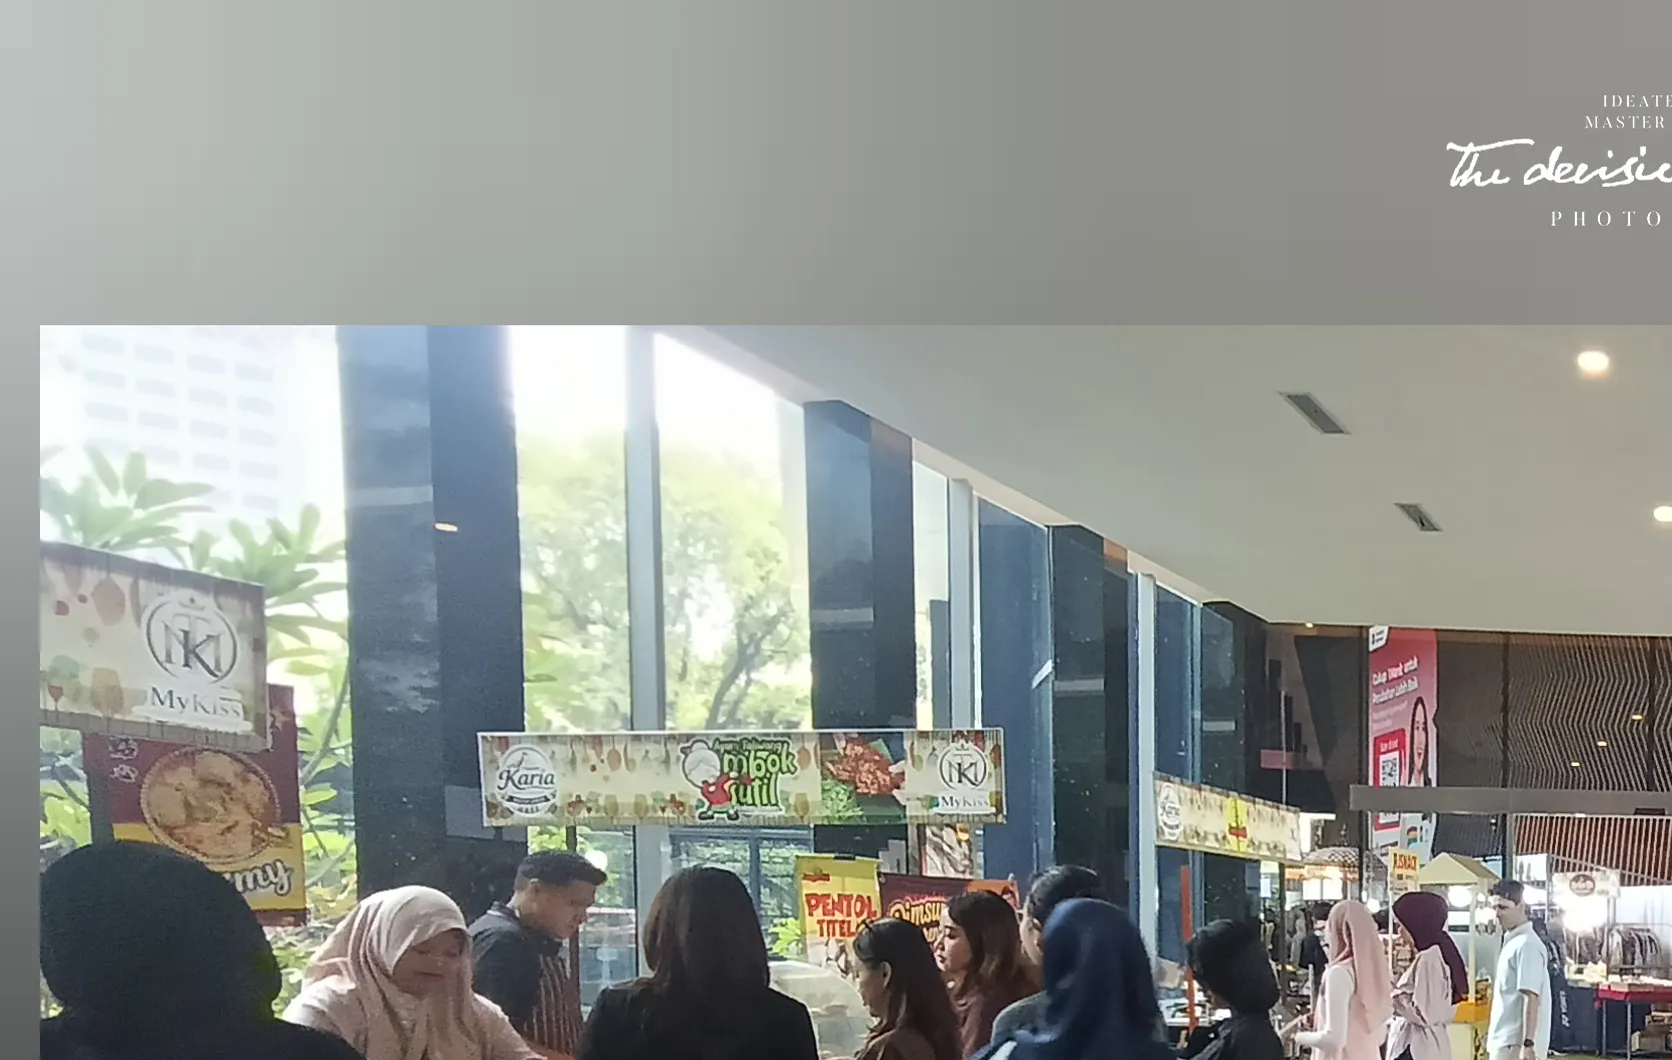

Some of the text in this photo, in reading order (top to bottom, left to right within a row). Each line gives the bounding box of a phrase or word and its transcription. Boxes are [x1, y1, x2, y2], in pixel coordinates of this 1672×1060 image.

[150, 686, 243, 719] MyKiss
[497, 769, 555, 790] Karia
[805, 892, 877, 920] PENTOL
[889, 899, 943, 927] Dimsu
